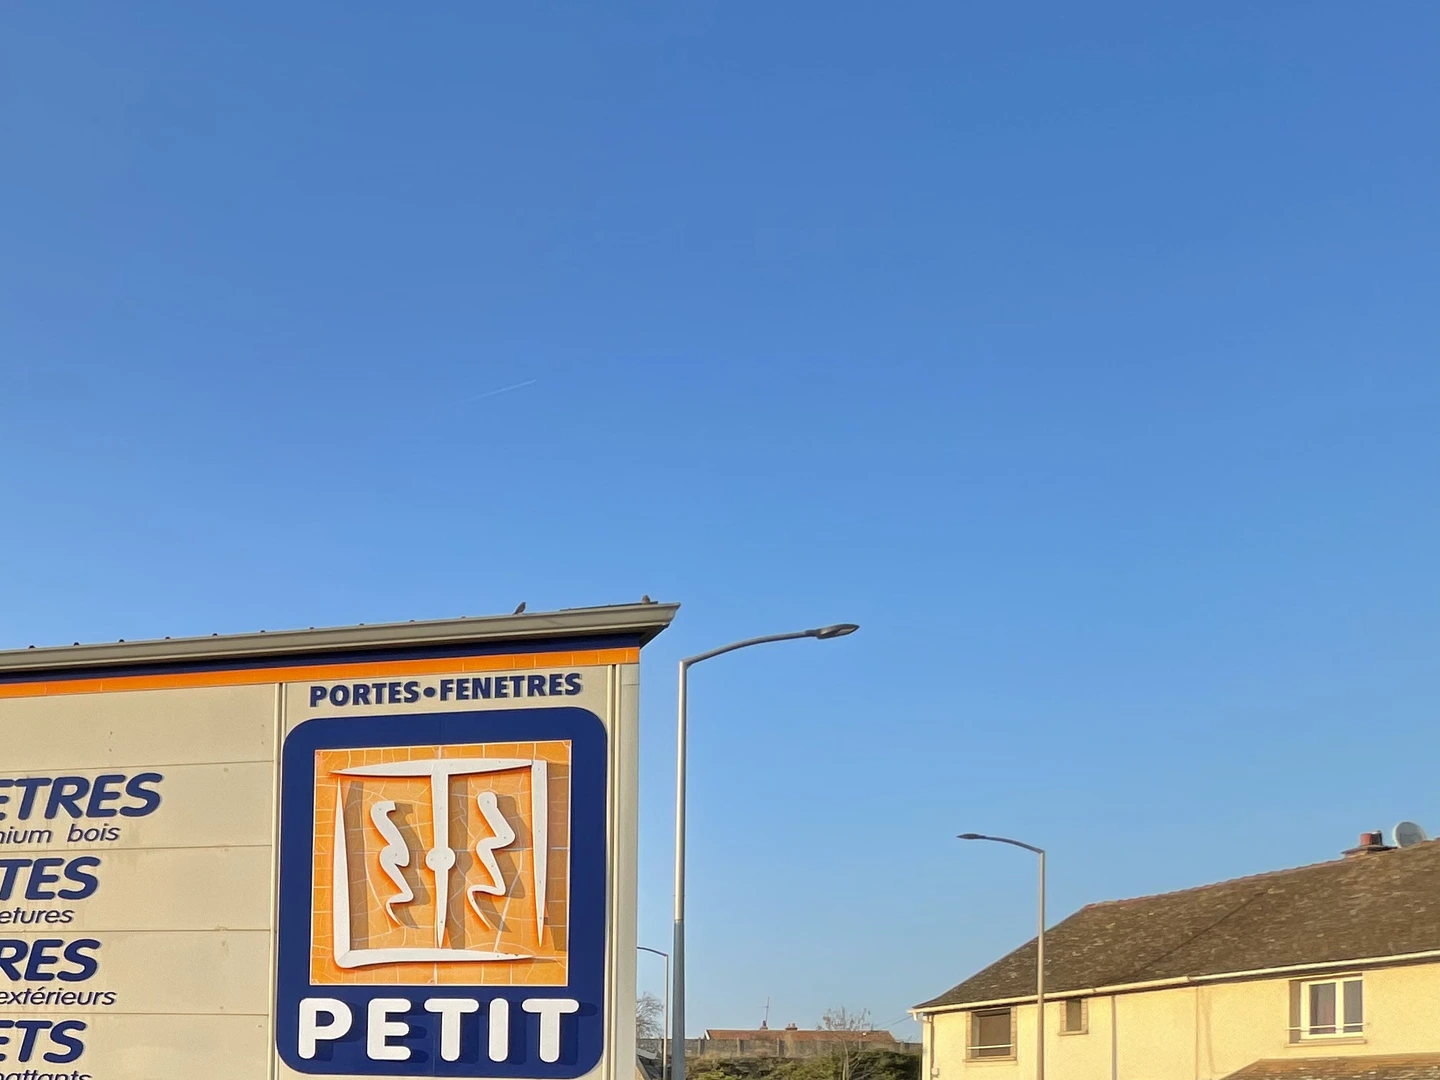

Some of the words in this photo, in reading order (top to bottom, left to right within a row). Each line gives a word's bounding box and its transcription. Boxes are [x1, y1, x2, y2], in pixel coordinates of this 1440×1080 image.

[309, 680, 420, 708] PORTES
[439, 672, 582, 702] FENETRES
[66, 822, 121, 844] bois
[297, 997, 581, 1064] PETIT
